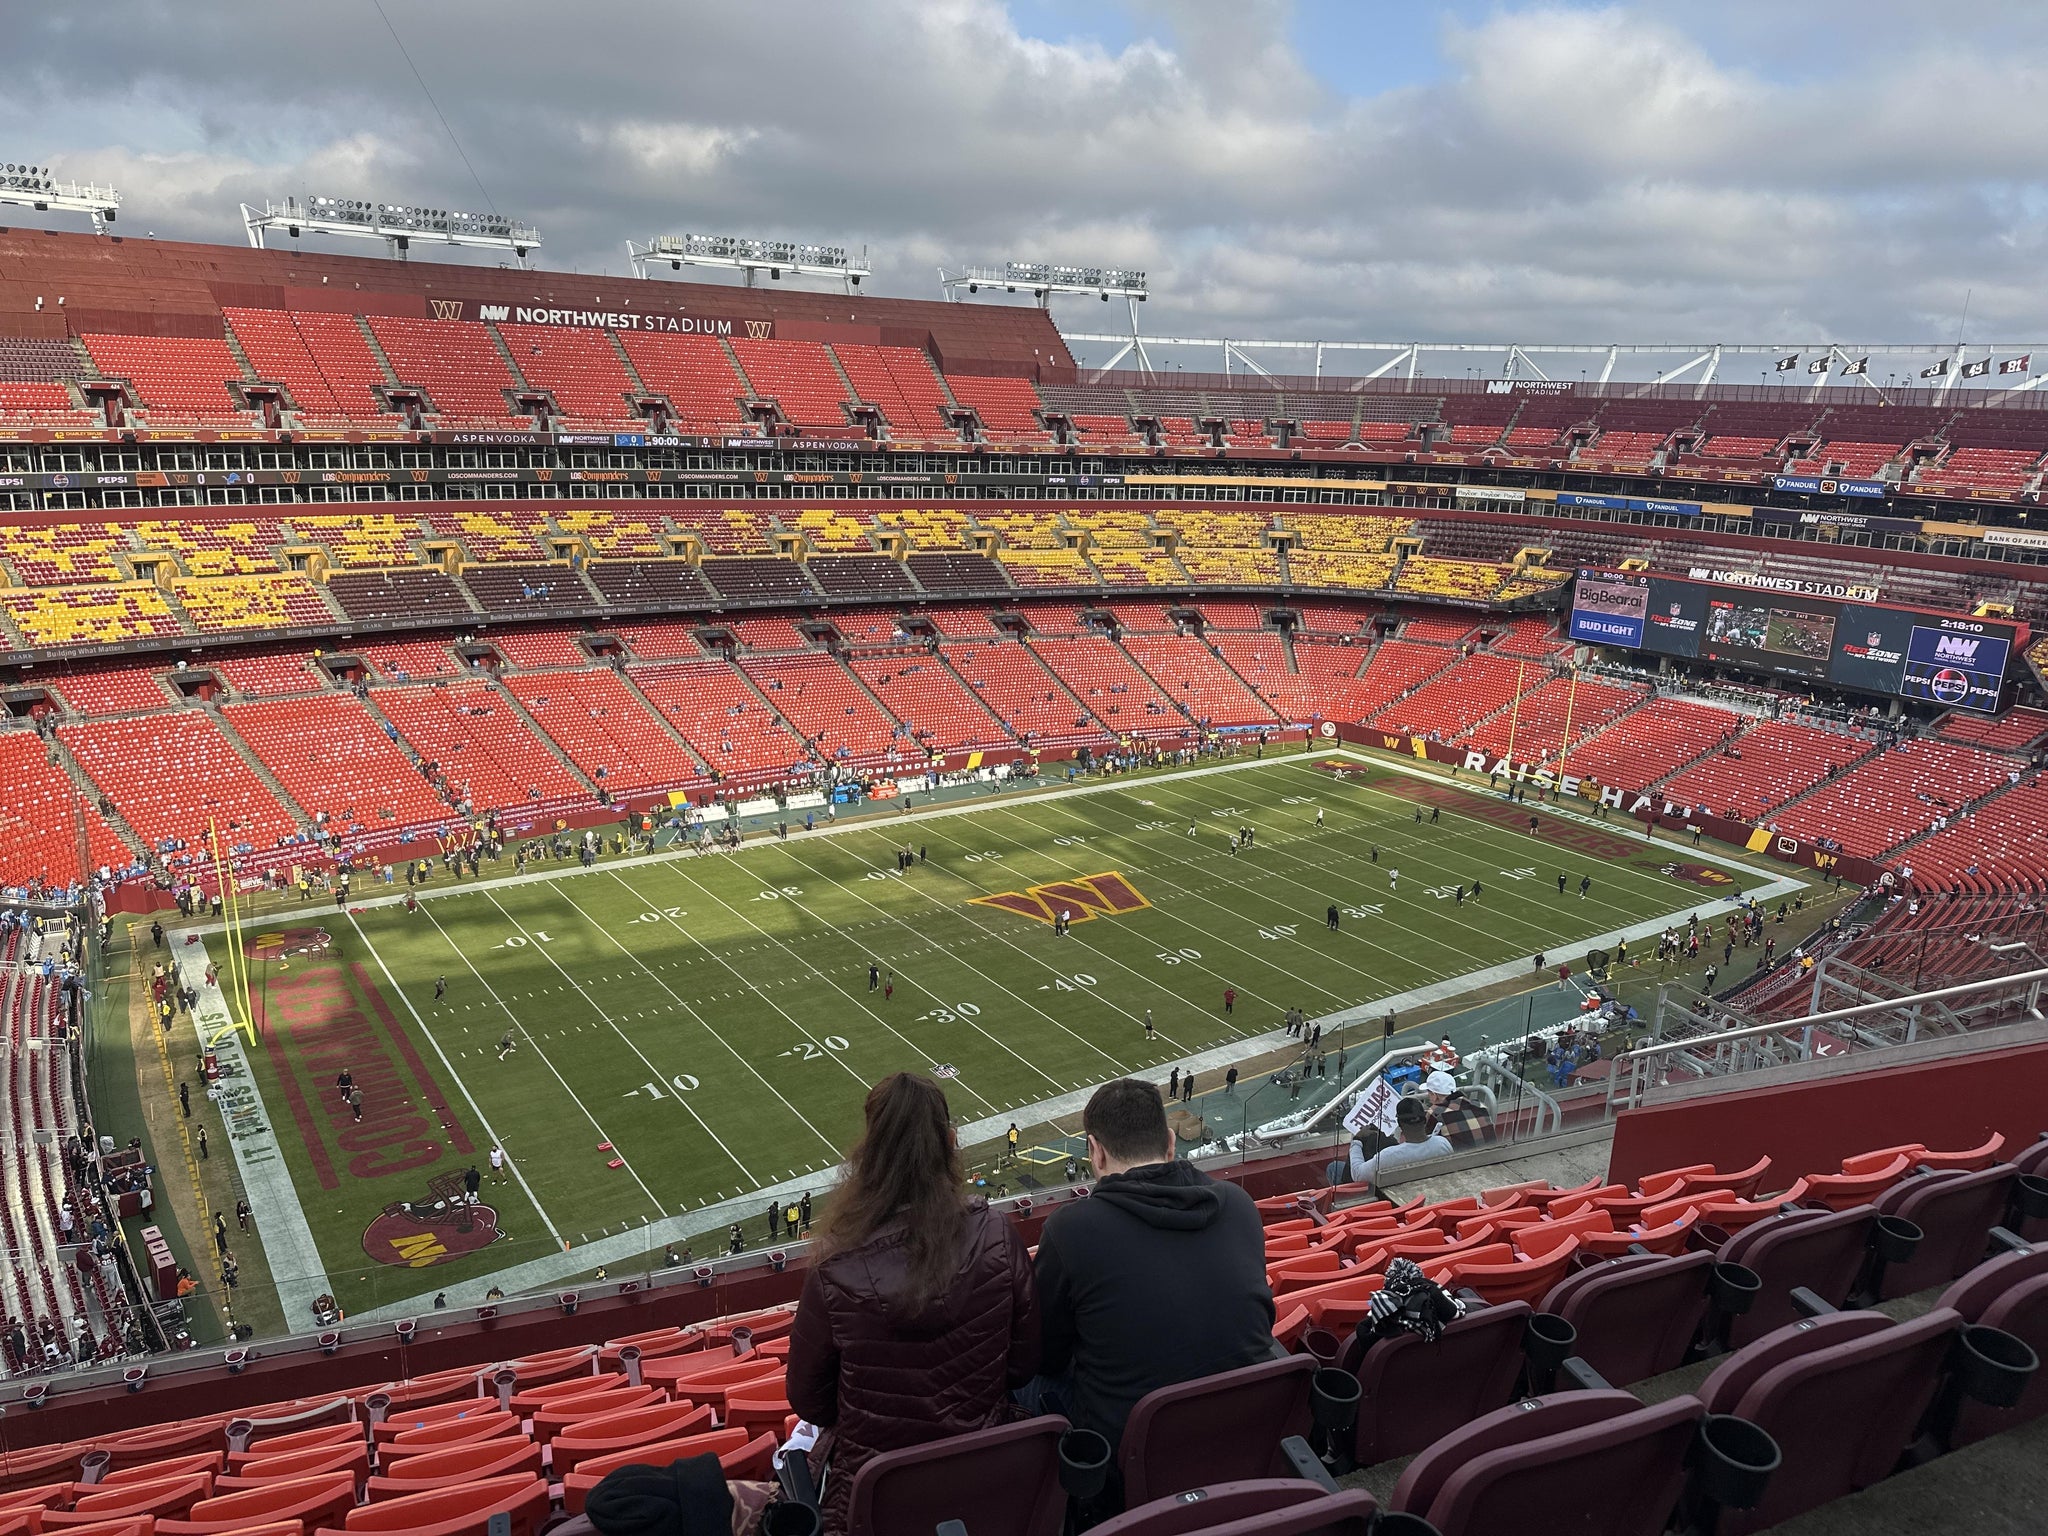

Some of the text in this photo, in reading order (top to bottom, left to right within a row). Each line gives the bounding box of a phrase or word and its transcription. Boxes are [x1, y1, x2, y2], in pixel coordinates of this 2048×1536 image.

[516, 307, 640, 329] NORTHWEST
[645, 316, 732, 335] STADIUM
[1515, 381, 1574, 391] NORTHWEST
[1526, 388, 1561, 396] STADIUM
[652, 436, 678, 446] 90:00
[0, 478, 24, 486] EPSI
[97, 476, 128, 484] PEPSI
[197, 473, 205, 484] 0
[247, 473, 254, 484] 0
[1786, 482, 1818, 490] FANDUEL
[1822, 482, 1835, 491] 25
[1849, 485, 1883, 494] FANDUEL
[1820, 515, 1868, 524] NORTHWEST
[1988, 535, 2010, 543] BANK
[2023, 538, 2048, 546] AMER
[1603, 572, 1624, 580] 90:00
[1712, 572, 1803, 592] NORTHWEST
[1579, 588, 1642, 608] BigBear.ai
[490, 613, 512, 621] Building
[286, 625, 353, 636] Building What Matters
[1579, 619, 1634, 636] BUD LIGHT
[1940, 619, 1984, 632] 2:18:10
[137, 641, 161, 649] CLARK
[172, 634, 244, 647] Building What Matters
[8, 653, 34, 661] CLARK
[46, 644, 125, 658] Building What Matters
[1934, 652, 1977, 663] NORTHWEST
[1904, 674, 1931, 686] PEPSI
[1934, 679, 1965, 694] PEPSI
[1969, 686, 1998, 698] PEPSI
[857, 759, 946, 777] COMMANDERS
[1463, 750, 1582, 797] RAISE
[1210, 806, 1245, 818] 20
[1375, 777, 1643, 858] COMMANDERS
[1135, 820, 1172, 832] 30
[1548, 808, 1630, 833] SERVICE
[1781, 840, 1794, 851] 25
[964, 850, 1004, 863] 50
[1500, 868, 1536, 881] 10
[758, 886, 804, 901] 30
[638, 906, 688, 923] 20
[1341, 903, 1385, 920] 30
[504, 929, 556, 949] 10
[1258, 924, 1296, 942] 40
[1155, 947, 1203, 966] 50
[1053, 972, 1099, 994] 40
[930, 1001, 982, 1025] 30
[199, 1012, 228, 1031] US
[794, 1034, 851, 1062] 20
[267, 967, 443, 1179] COMMANDERS
[640, 1073, 700, 1102] 10
[242, 1146, 276, 1165] IT
[1522, 1401, 1536, 1411] 12
[1185, 1490, 1199, 1502] 13
